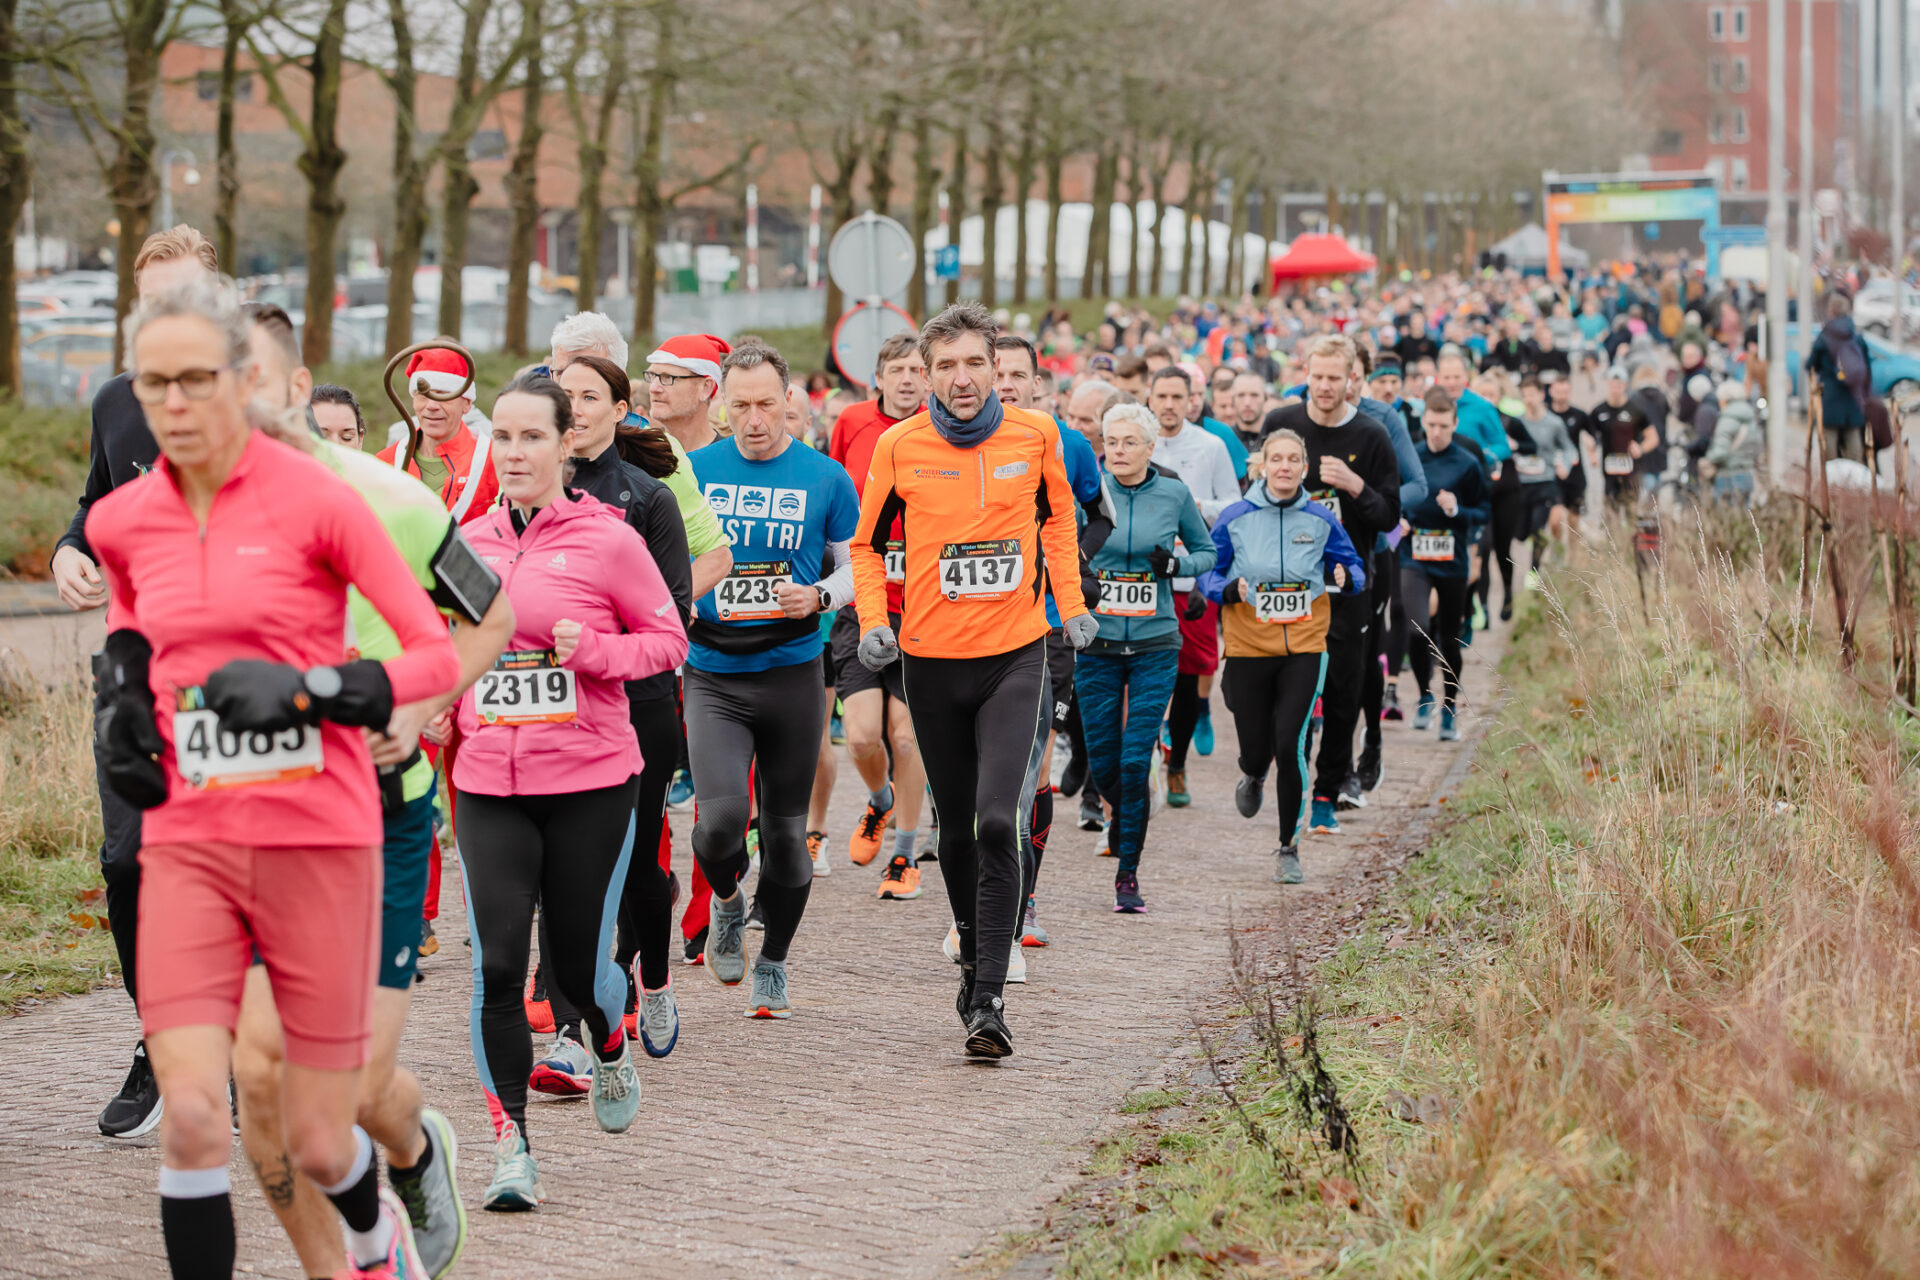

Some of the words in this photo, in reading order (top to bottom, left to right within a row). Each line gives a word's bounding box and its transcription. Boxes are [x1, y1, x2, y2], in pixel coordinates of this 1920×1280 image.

[765, 521, 804, 550] TRI
[945, 557, 1017, 587] 4137
[1101, 583, 1153, 604] 2106
[1260, 592, 1306, 612] 2091
[482, 671, 568, 706] 2319
